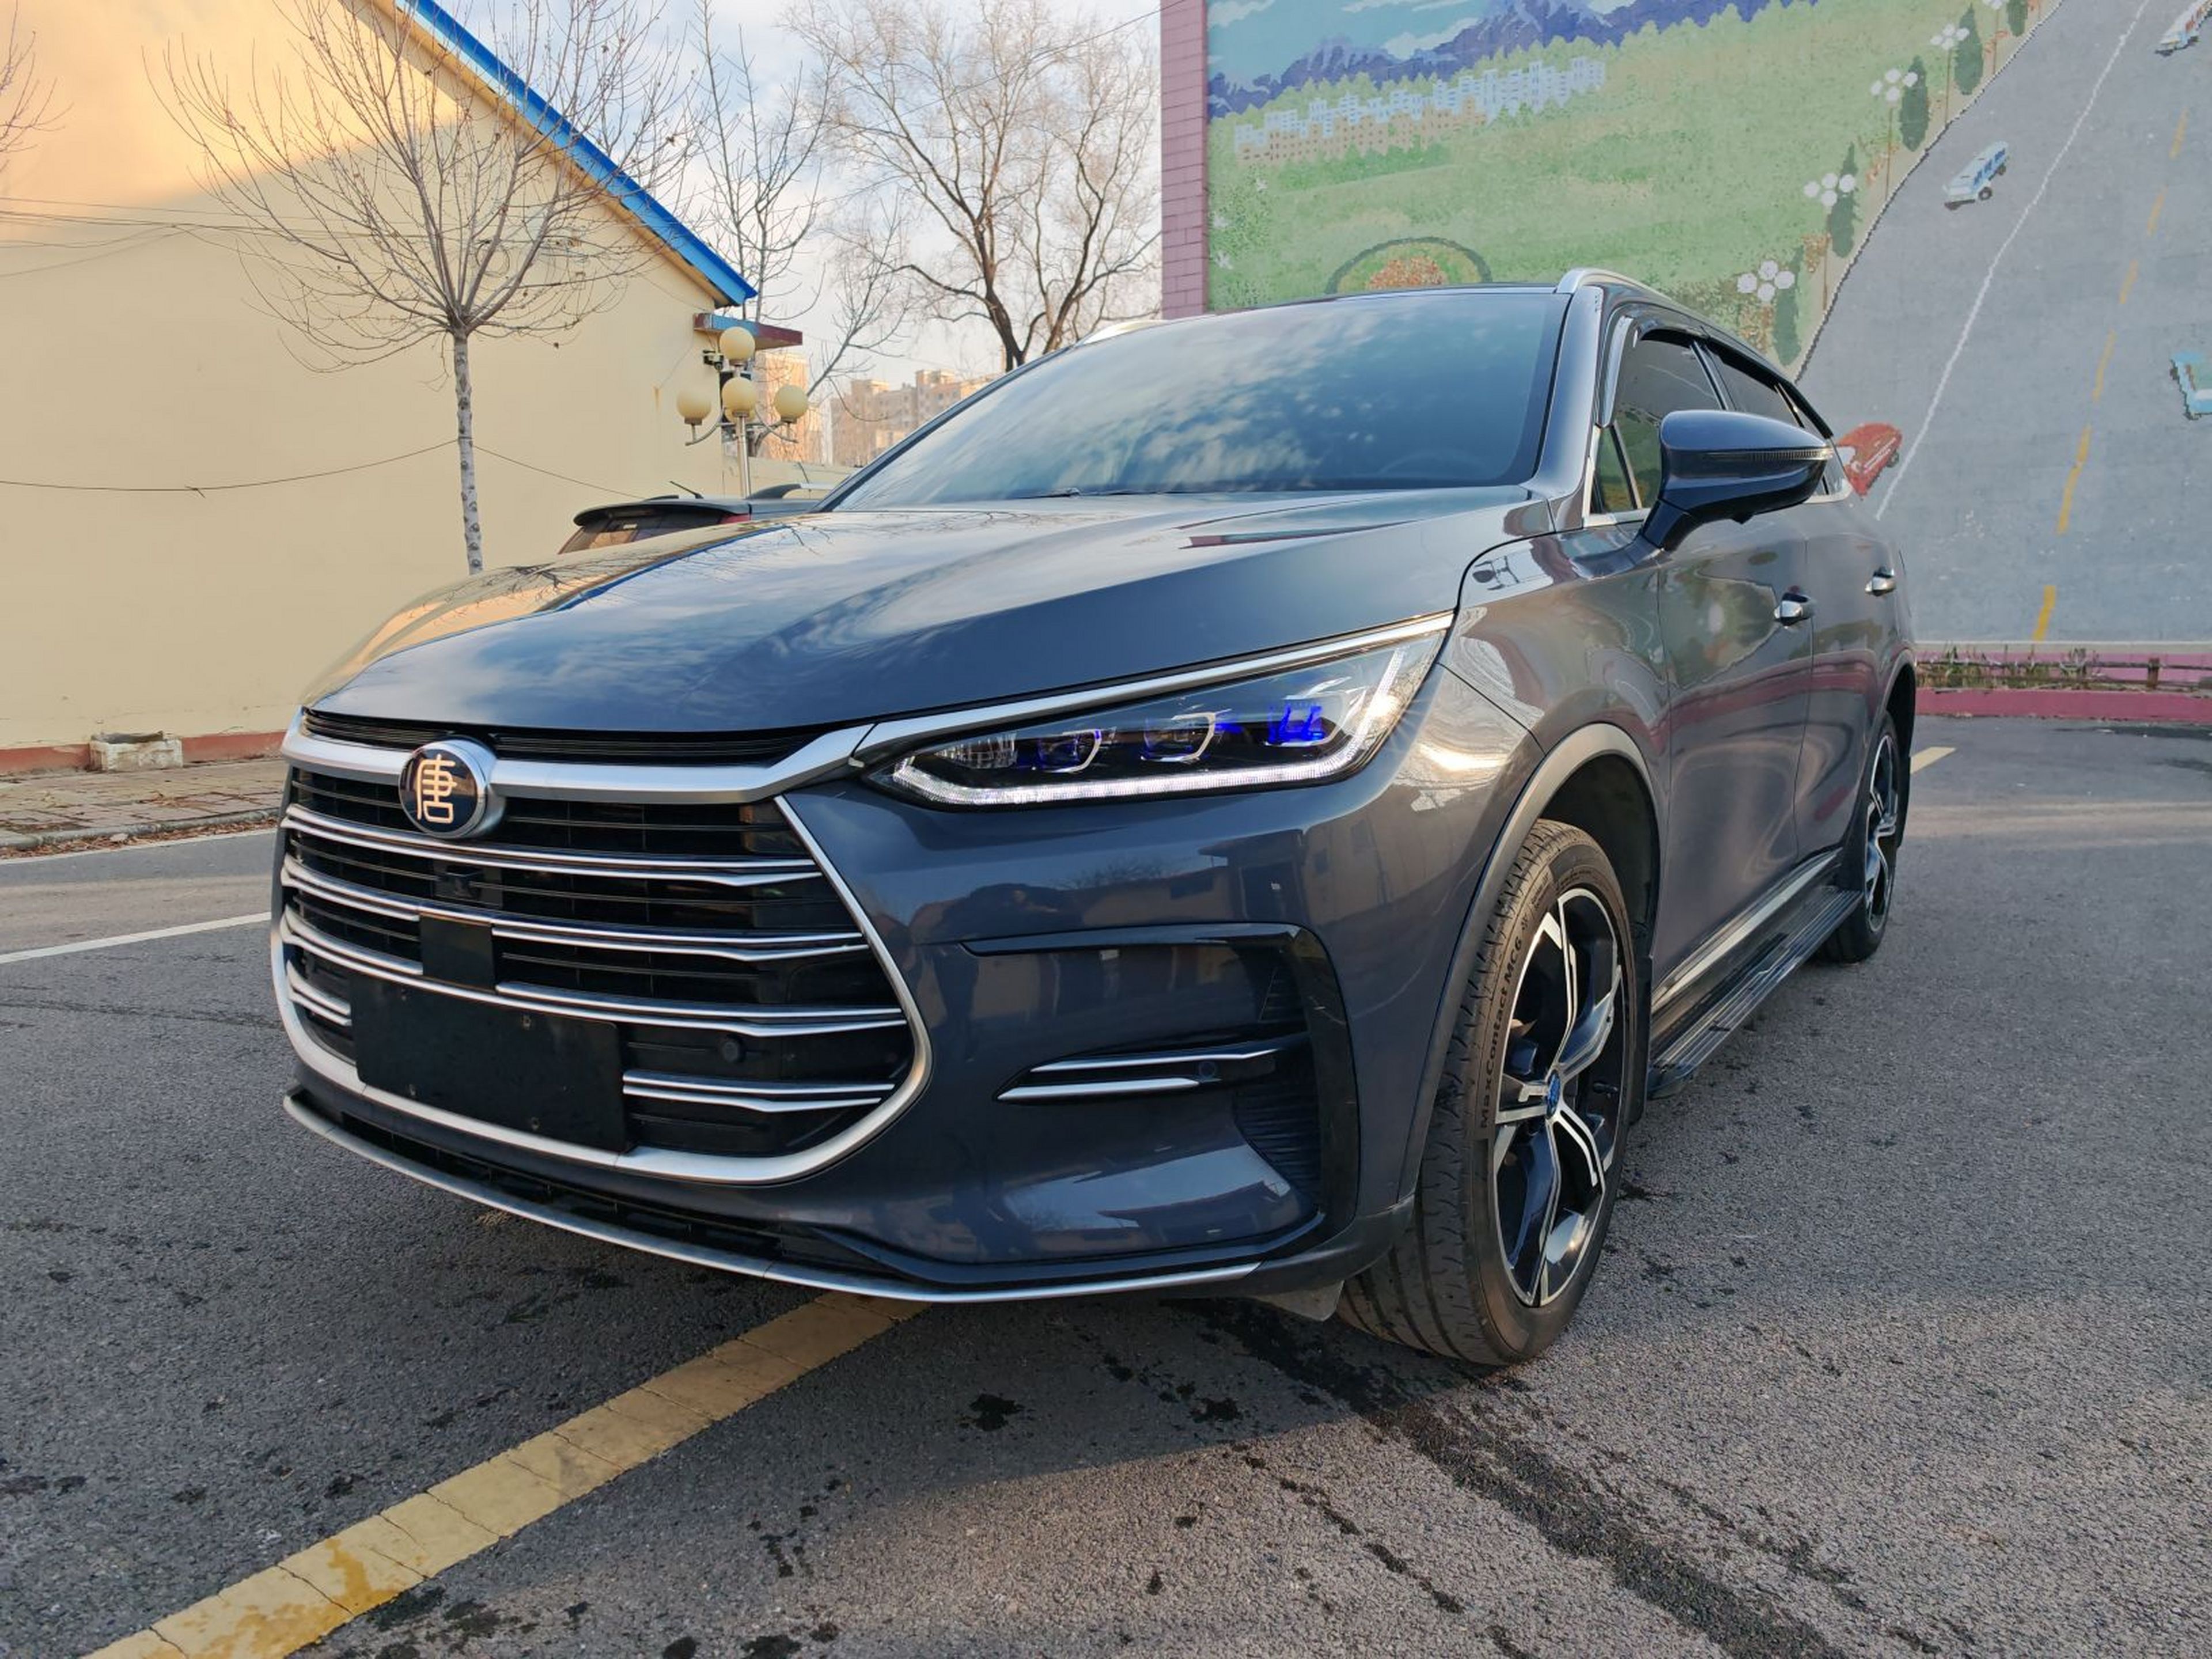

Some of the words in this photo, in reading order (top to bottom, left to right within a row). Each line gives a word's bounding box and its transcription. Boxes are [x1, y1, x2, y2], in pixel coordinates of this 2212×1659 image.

[416, 753, 458, 824] 唐
[1480, 987, 1508, 1128] MaxContact
[1504, 936, 1522, 983] MC6
